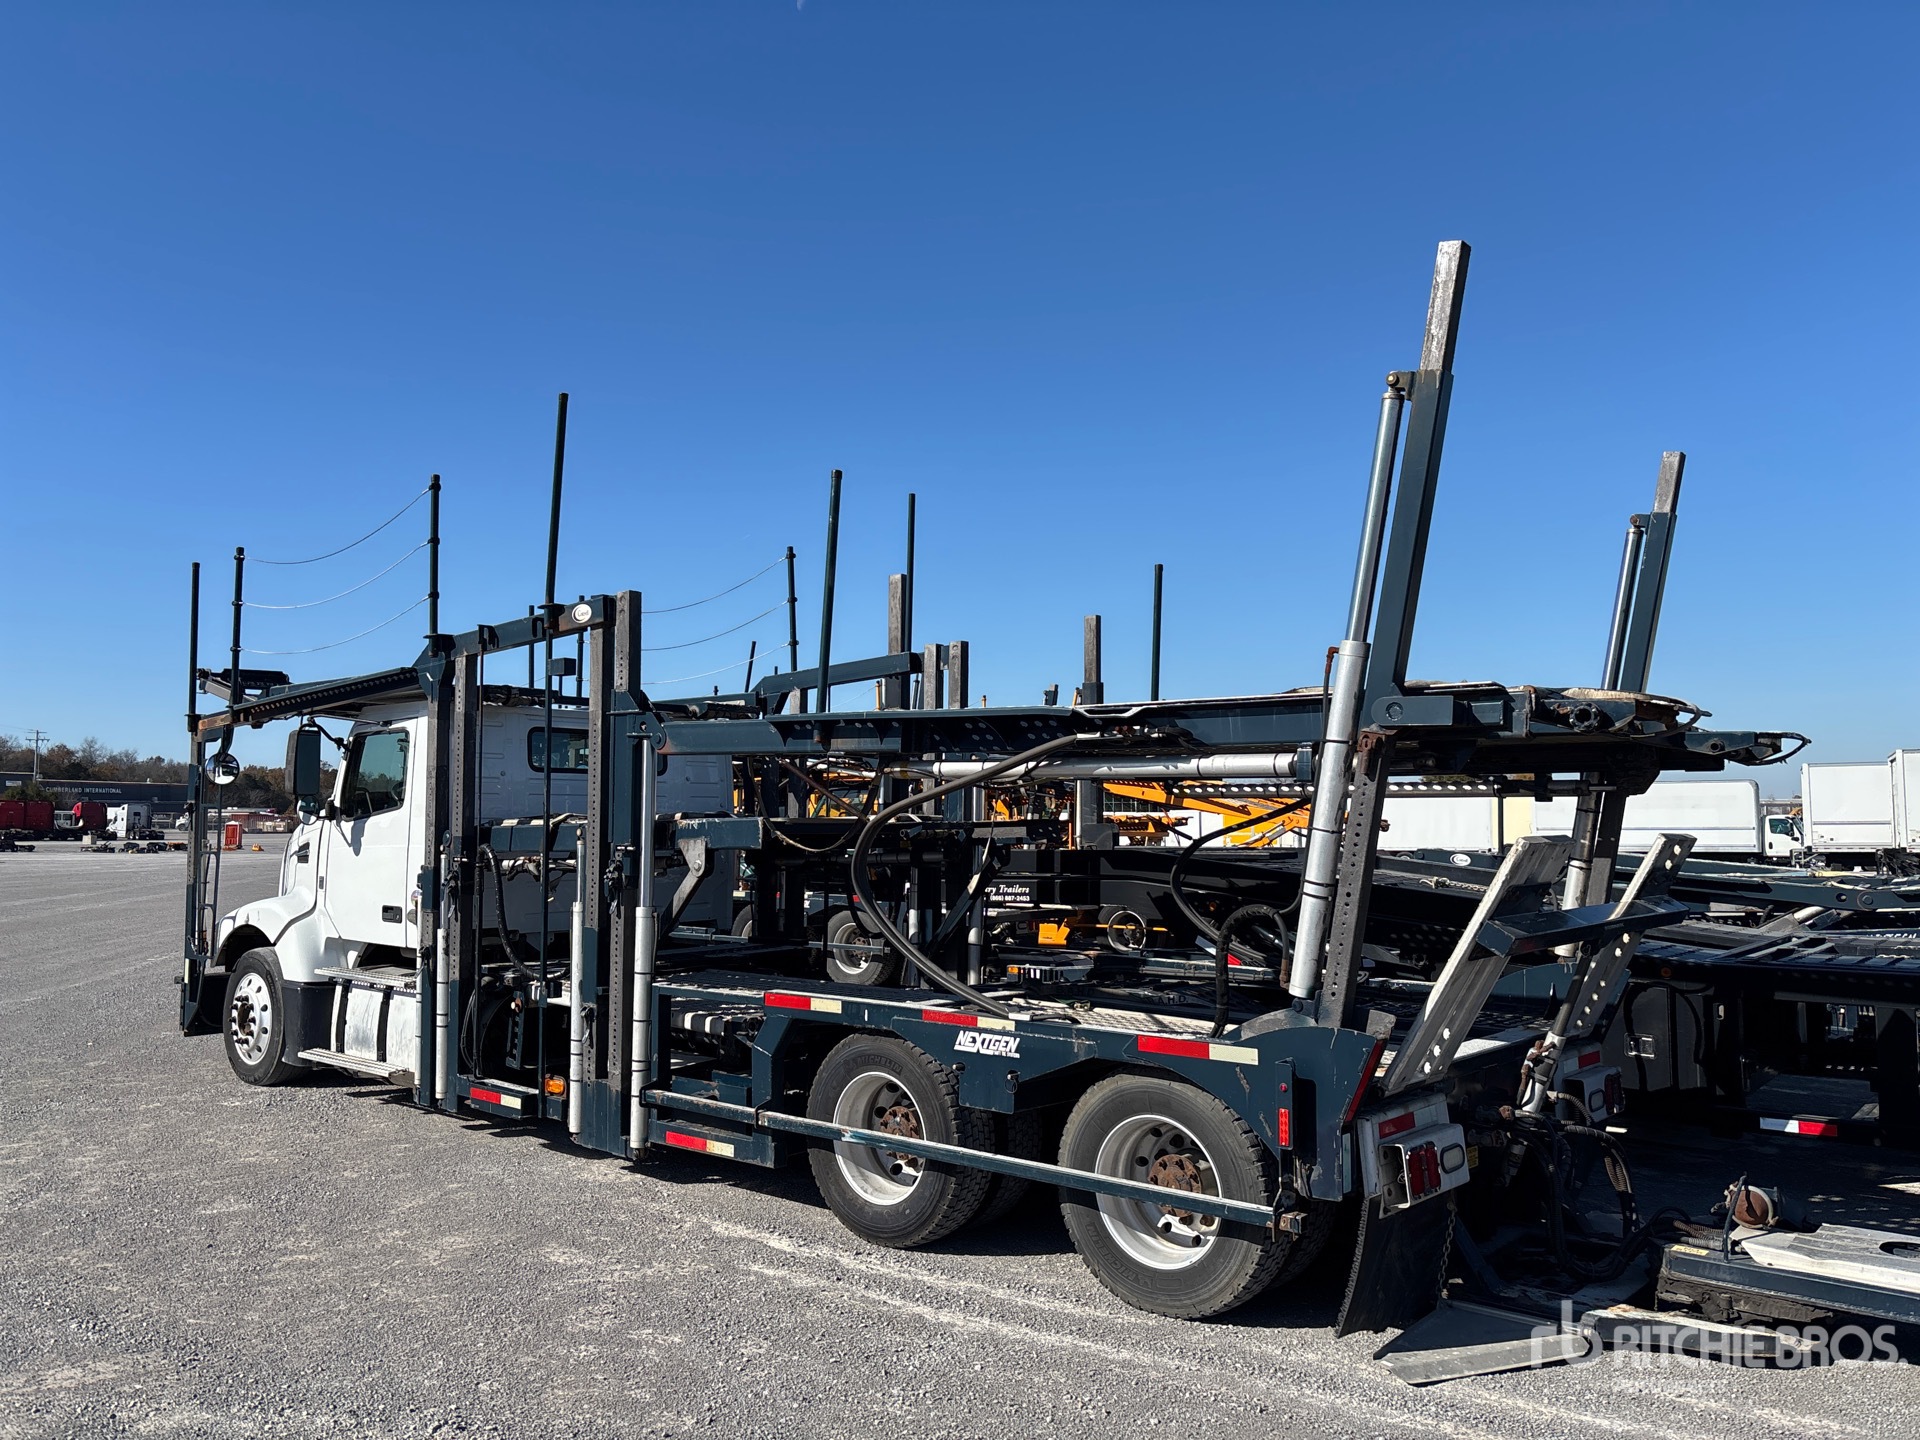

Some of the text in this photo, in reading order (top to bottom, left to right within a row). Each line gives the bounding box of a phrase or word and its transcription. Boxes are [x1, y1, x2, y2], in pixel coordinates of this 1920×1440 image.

[999, 884, 1030, 893] Trailers
[953, 1030, 1020, 1055] NEXTGEN
[856, 1055, 903, 1075] MICHELIN
